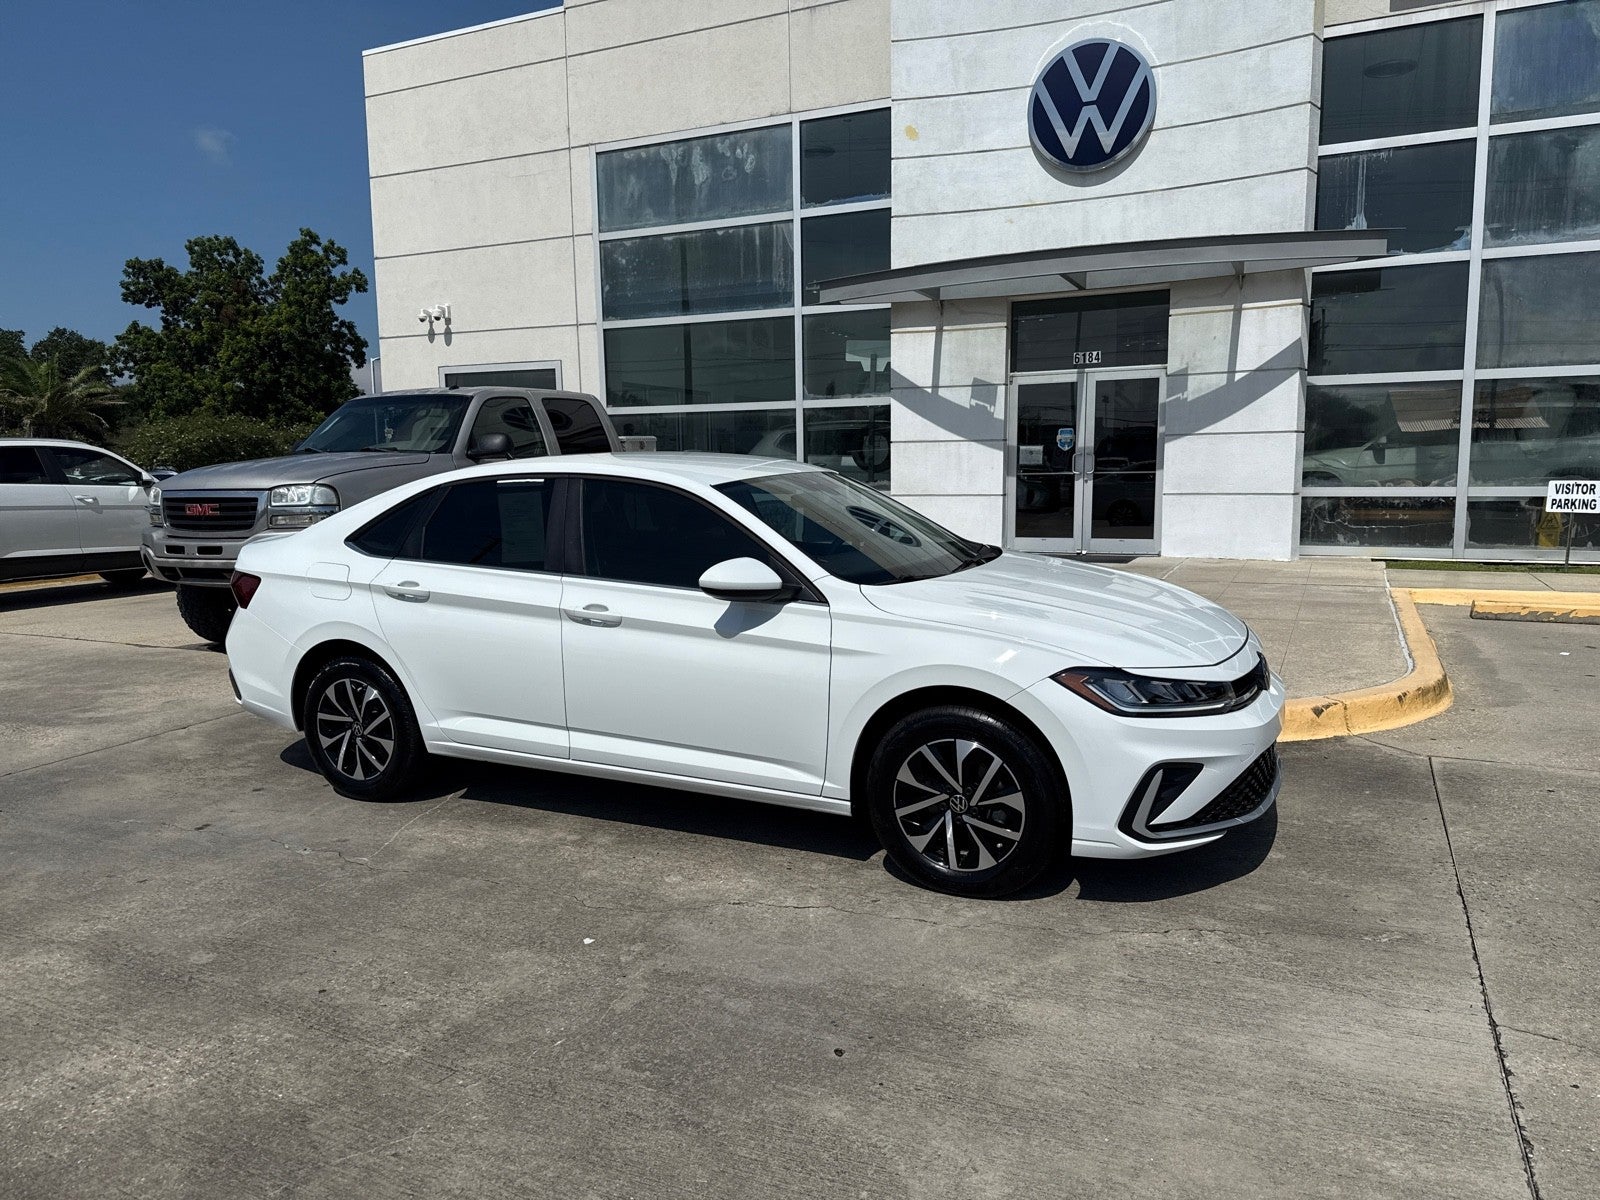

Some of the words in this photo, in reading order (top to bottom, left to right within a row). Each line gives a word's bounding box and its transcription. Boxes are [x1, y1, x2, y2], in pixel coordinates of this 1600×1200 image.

[1032, 42, 1150, 160] VW
[1074, 351, 1101, 364] 6184
[1555, 483, 1596, 495] VISITOR
[185, 503, 220, 516] GMC
[1550, 498, 1597, 510] PARKING
